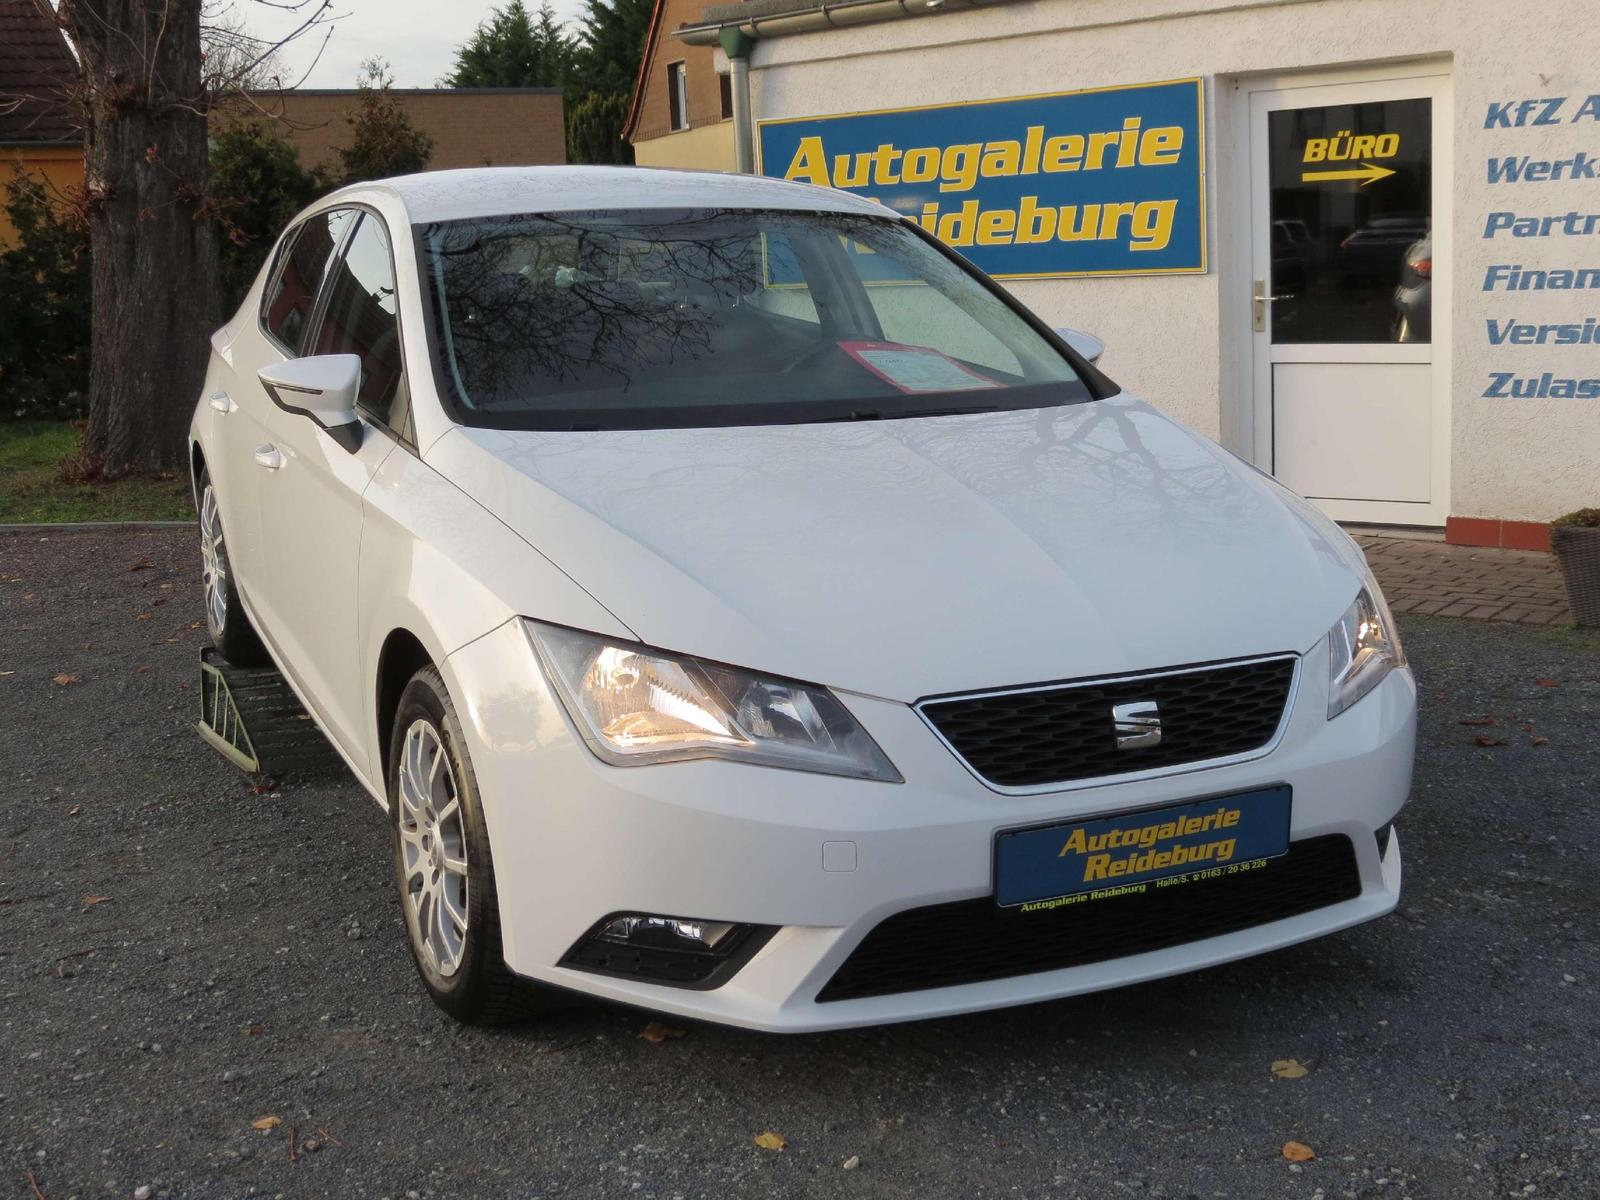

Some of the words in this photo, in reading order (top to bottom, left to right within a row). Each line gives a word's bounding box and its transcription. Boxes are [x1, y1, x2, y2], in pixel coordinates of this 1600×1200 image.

[1482, 97, 1567, 129] KfZ
[783, 117, 1185, 193] Autogalerie
[1302, 131, 1400, 162] BÜRO
[1487, 152, 1600, 184] Werk
[864, 196, 1178, 252] ideburg
[1057, 808, 1241, 857] Autogalerie
[1083, 837, 1237, 882] Reideburg
[1020, 893, 1088, 912] Autogalerie
[1091, 884, 1147, 900] Reideburg
[1201, 868, 1221, 880] 0163
